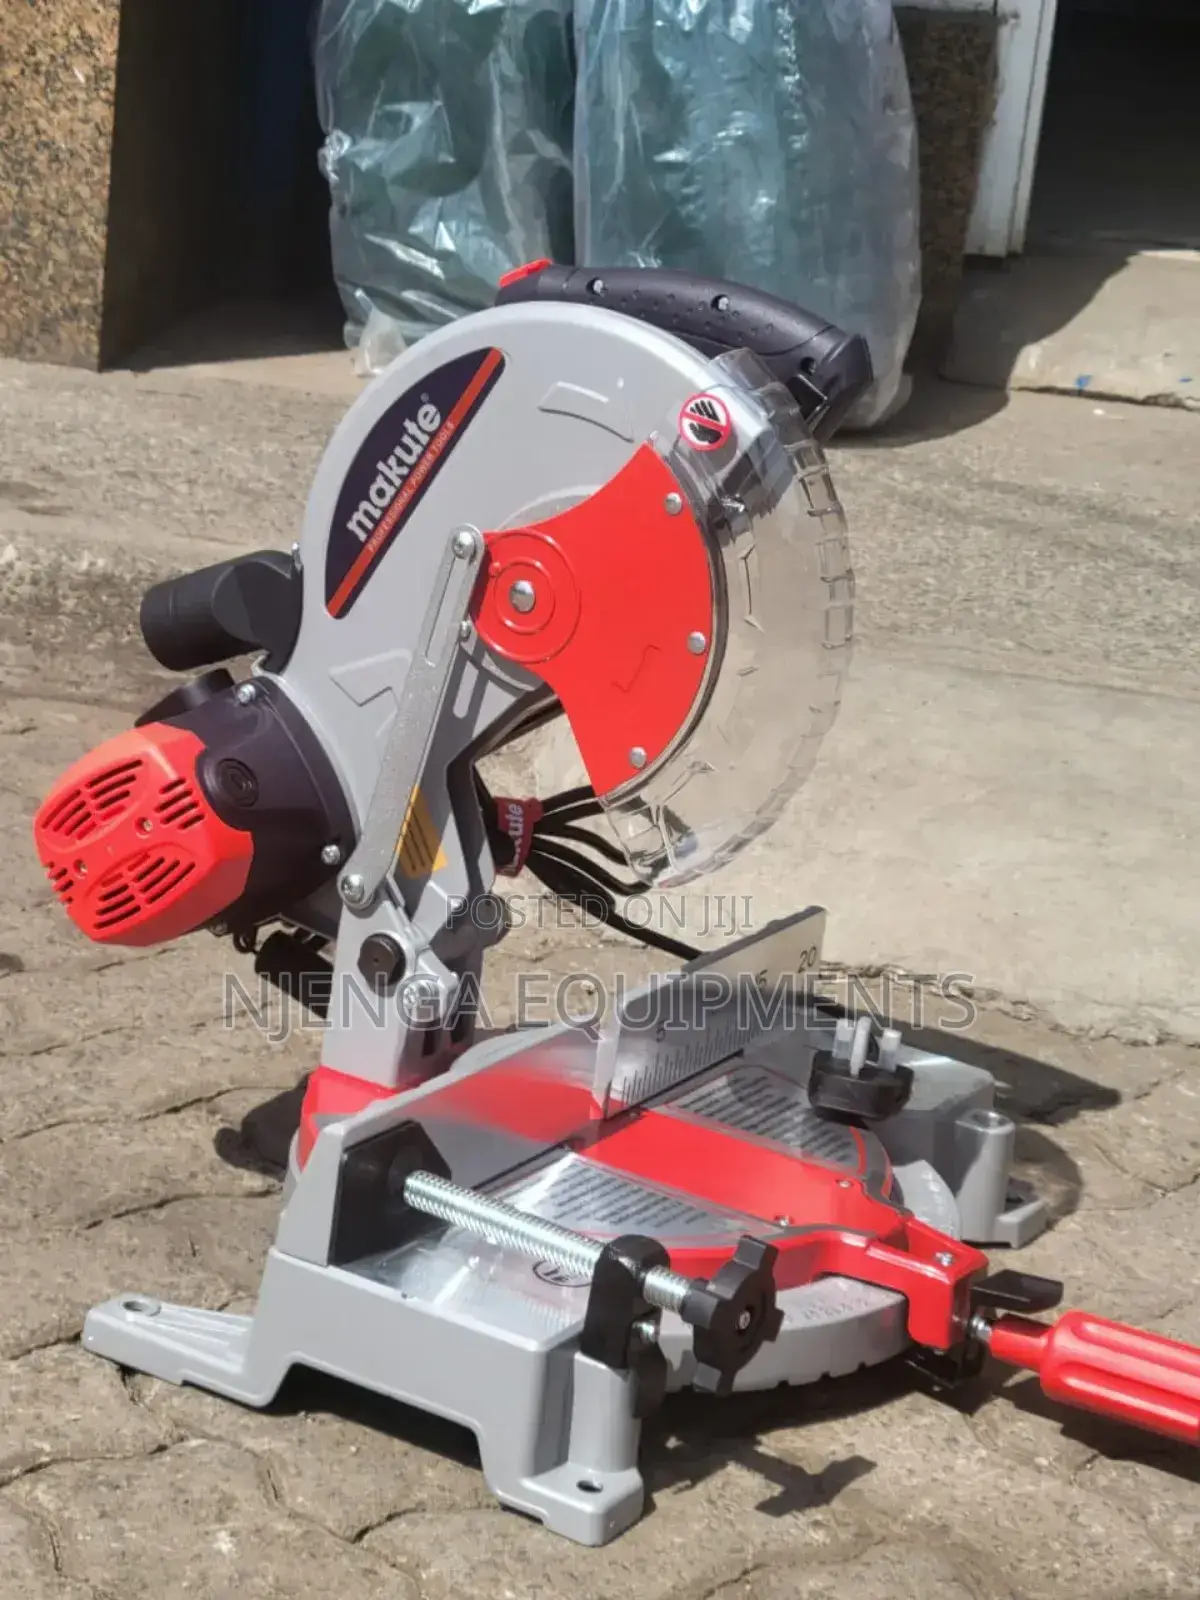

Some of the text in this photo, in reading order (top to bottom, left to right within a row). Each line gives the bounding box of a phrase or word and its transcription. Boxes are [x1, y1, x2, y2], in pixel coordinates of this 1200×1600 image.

[429, 419, 455, 453] TOOLS
[346, 402, 442, 543] makute
[798, 945, 817, 973] 20
